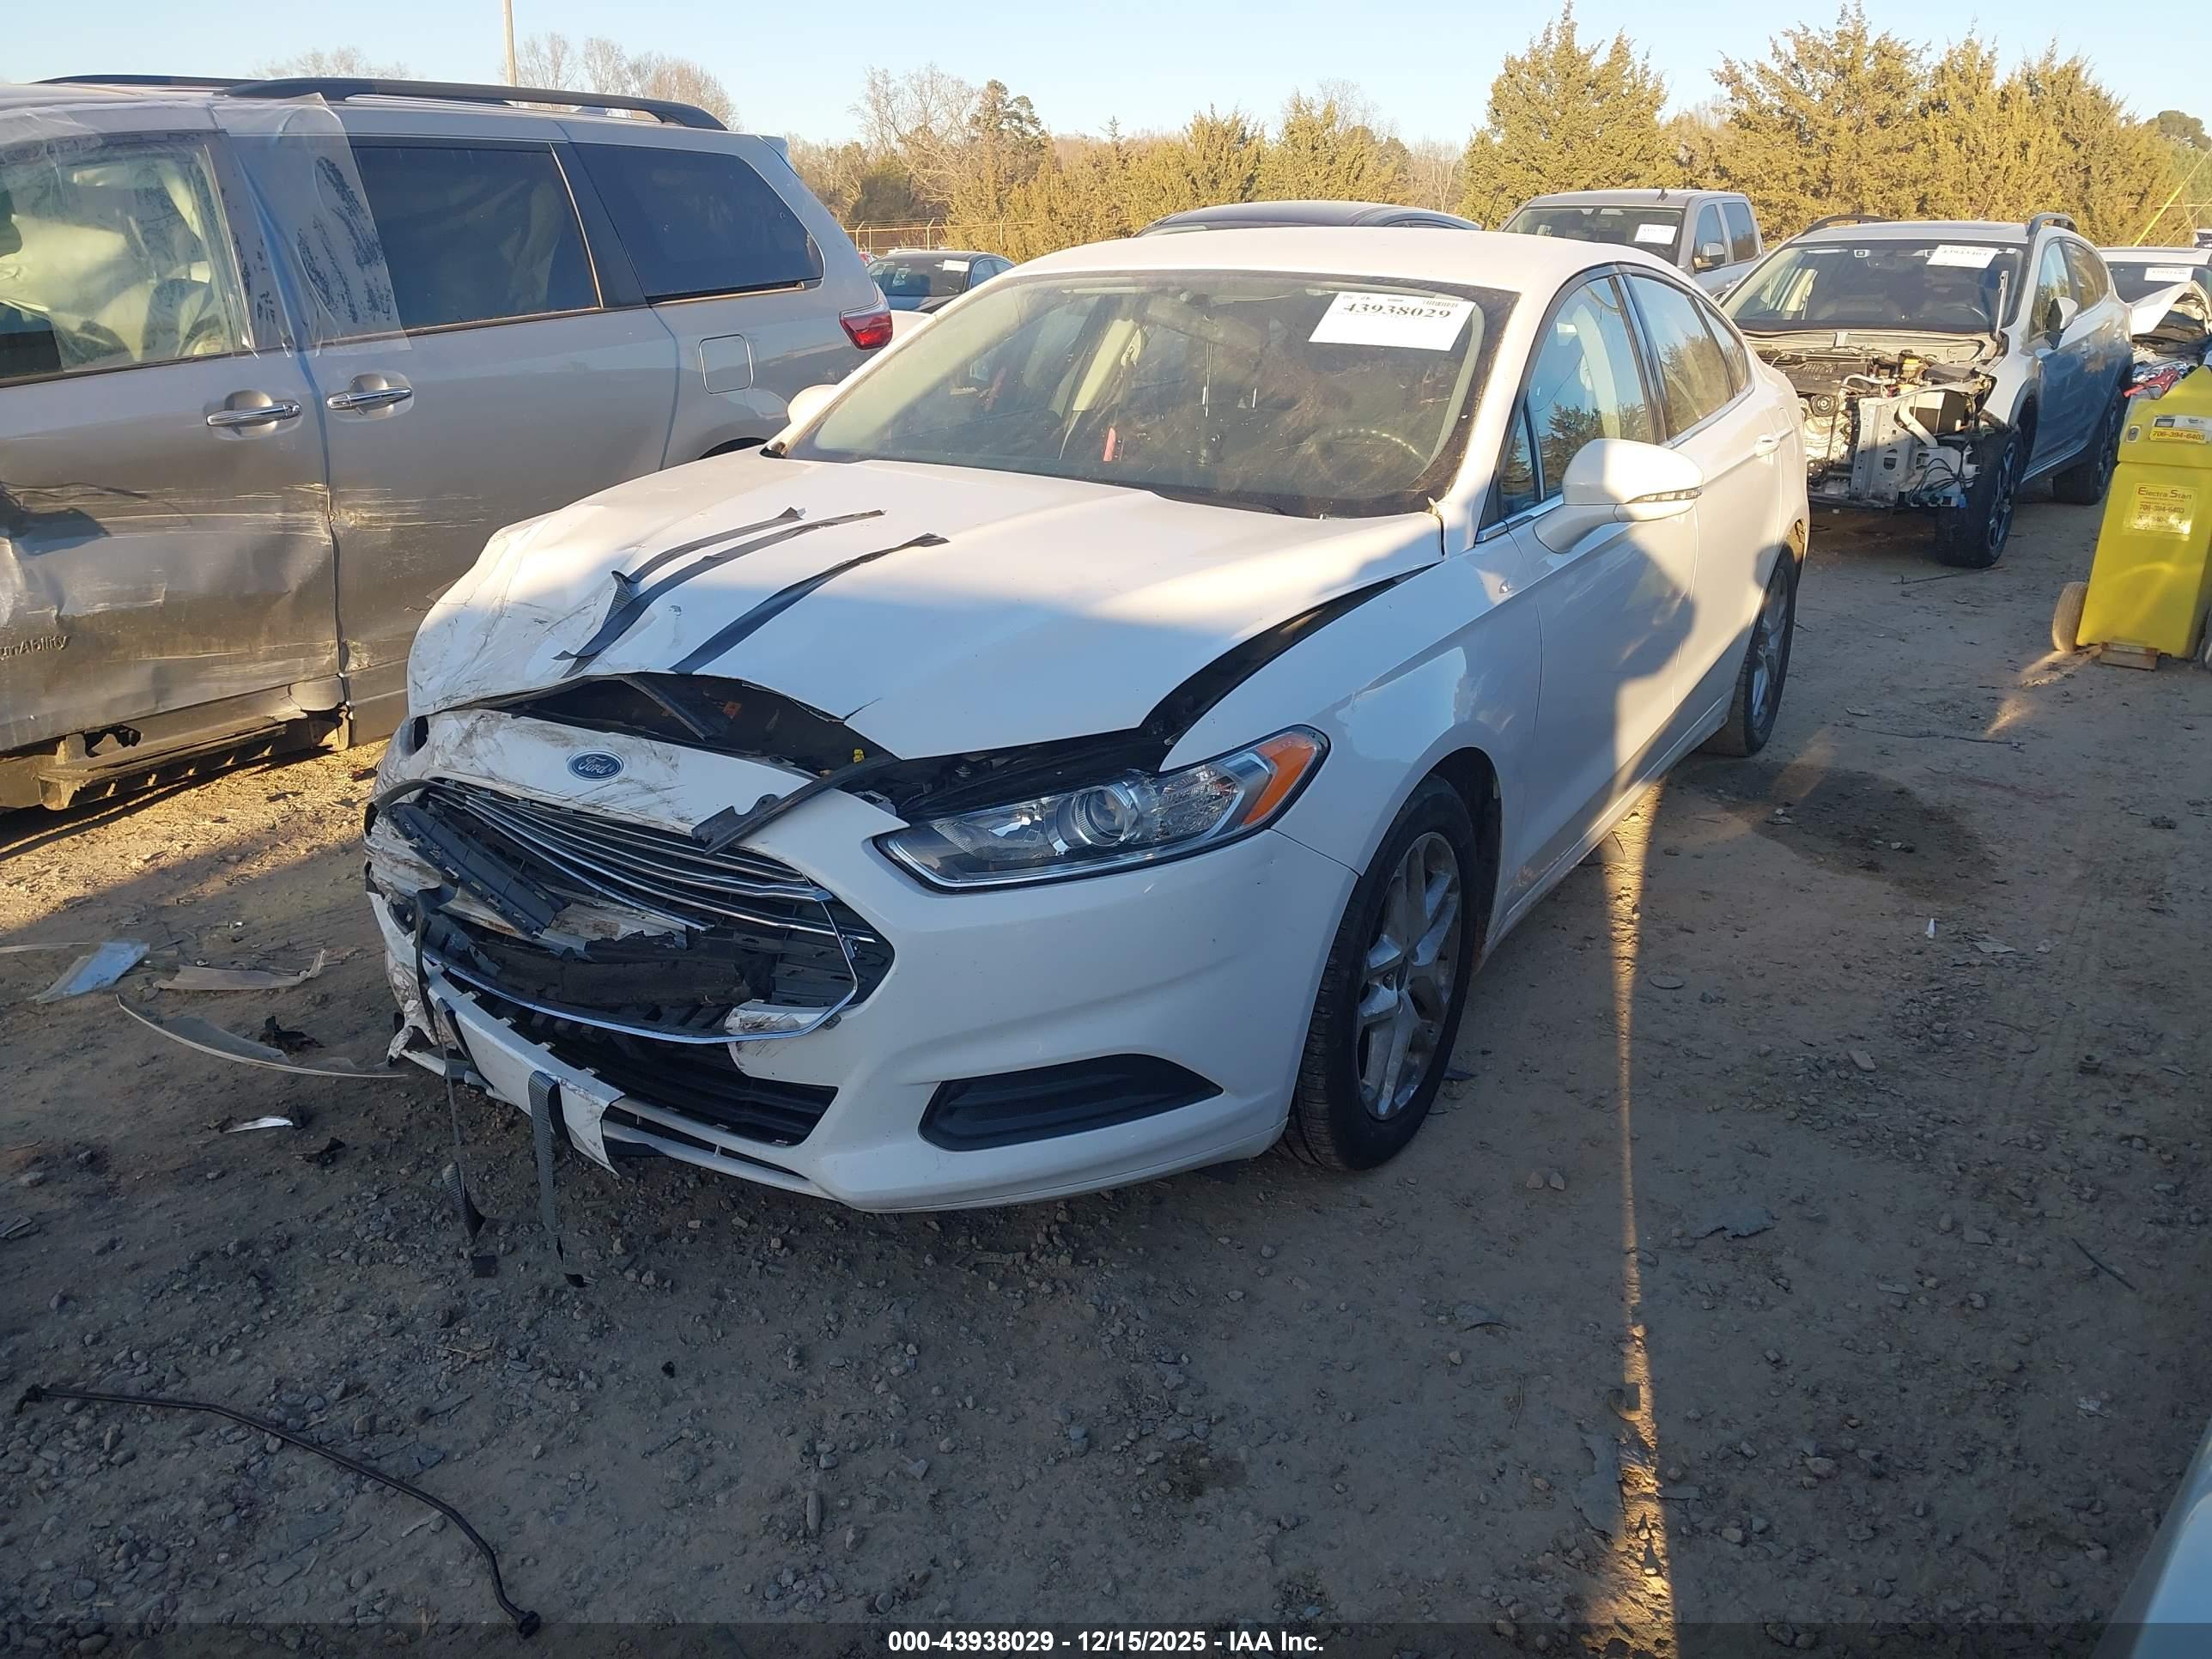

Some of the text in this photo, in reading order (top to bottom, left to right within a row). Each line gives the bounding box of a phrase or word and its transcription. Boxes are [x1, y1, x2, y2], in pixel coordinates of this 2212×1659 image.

[1343, 303, 1451, 318] 43938029
[2137, 486, 2168, 498] Electra
[578, 756, 611, 775] Ford
